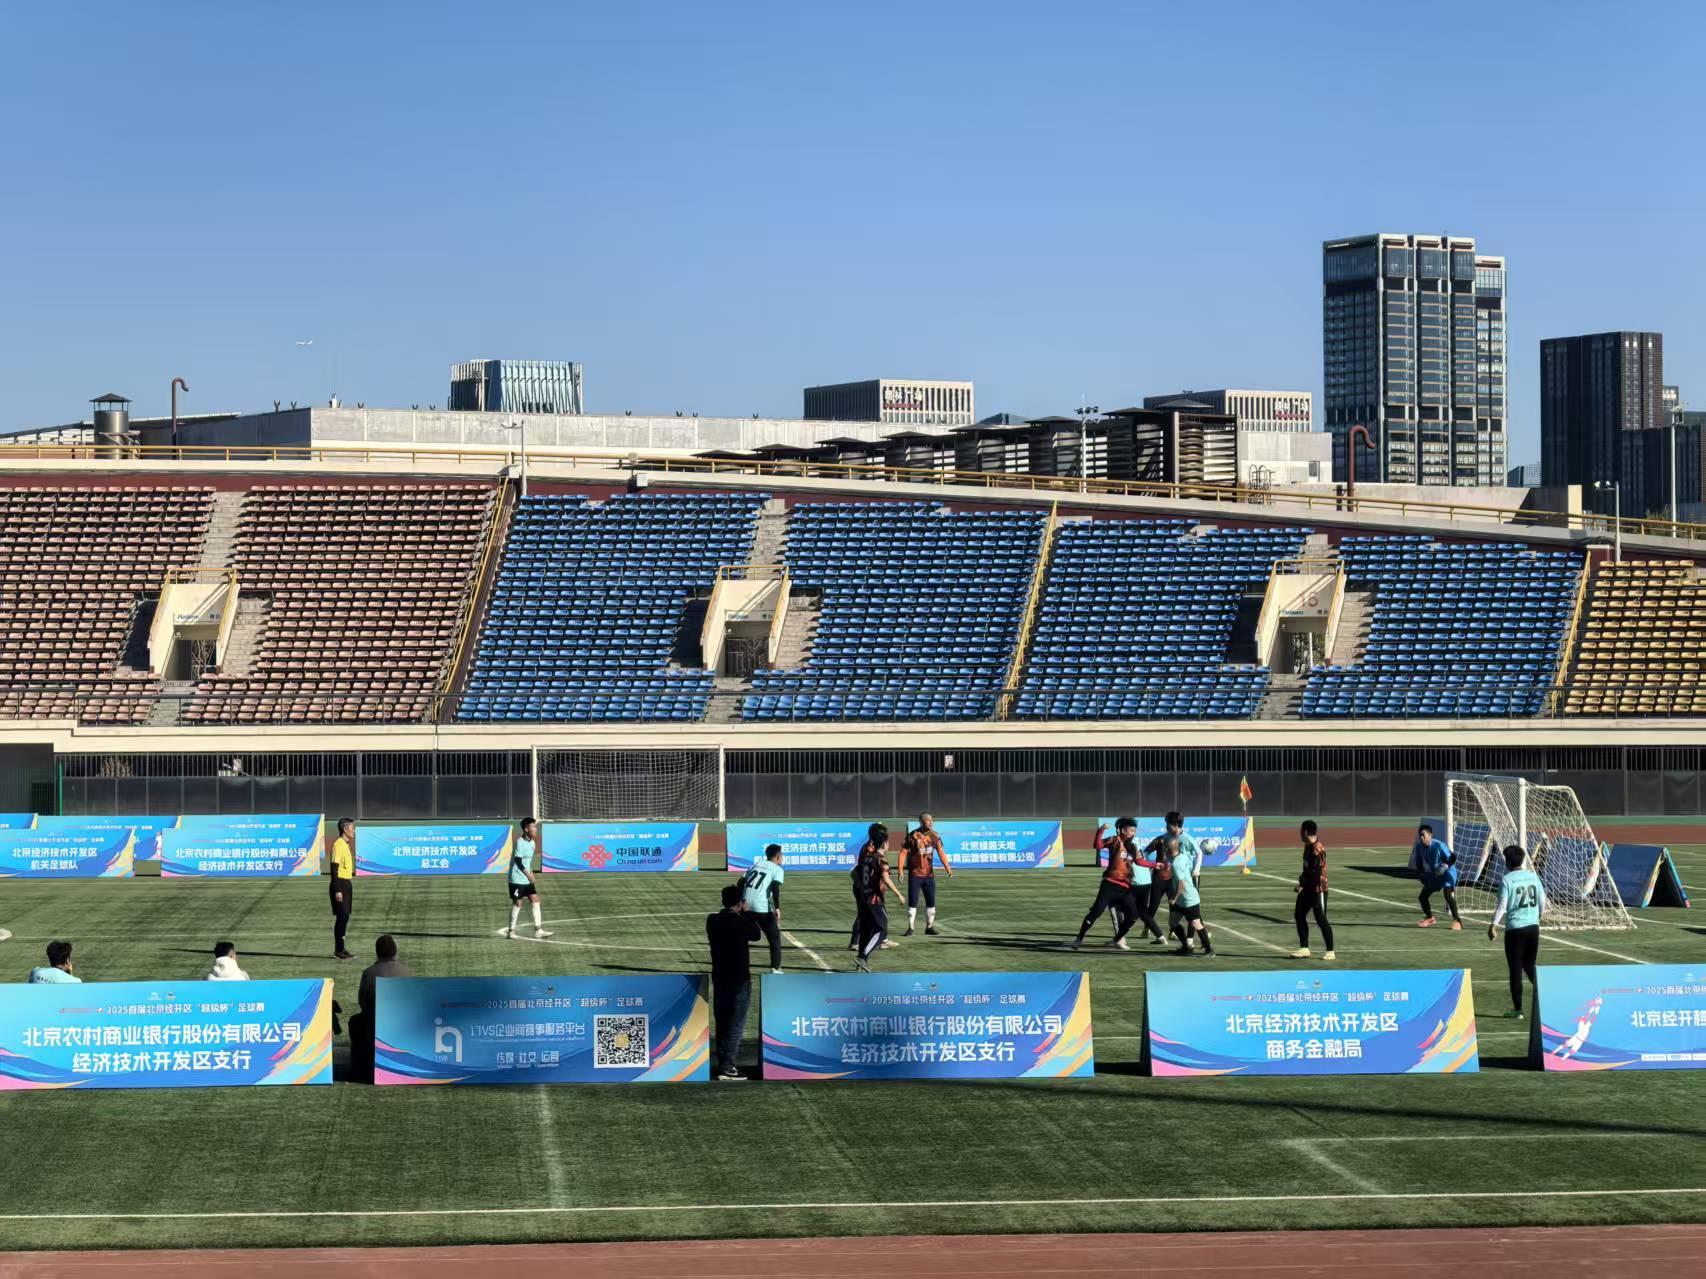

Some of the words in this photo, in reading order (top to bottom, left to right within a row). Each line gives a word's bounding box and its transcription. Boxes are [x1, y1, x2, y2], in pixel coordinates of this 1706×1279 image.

[12, 847, 98, 858] 北京经济技术开发区
[175, 847, 307, 859] 北京农村商业银行股份有限公司
[392, 845, 478, 857] 北京经济技术开发区
[616, 846, 662, 857] 中国联通
[31, 860, 78, 871] 机关足球队
[198, 860, 284, 872] 经济技术开发区支行
[421, 858, 450, 869] 总工会
[746, 870, 767, 890] 27
[1516, 884, 1538, 909] 29
[791, 1015, 1063, 1037] 北京农村商业银行股份有限公司
[1226, 1012, 1400, 1034] 北京经济技术开发区
[22, 1022, 302, 1048] 北京农村商业银行股份有限公司
[841, 1041, 1016, 1064] 经济技术开发区支行
[1265, 1039, 1363, 1060] 商务金融局
[72, 1050, 252, 1074] 经济技术开发区支行
